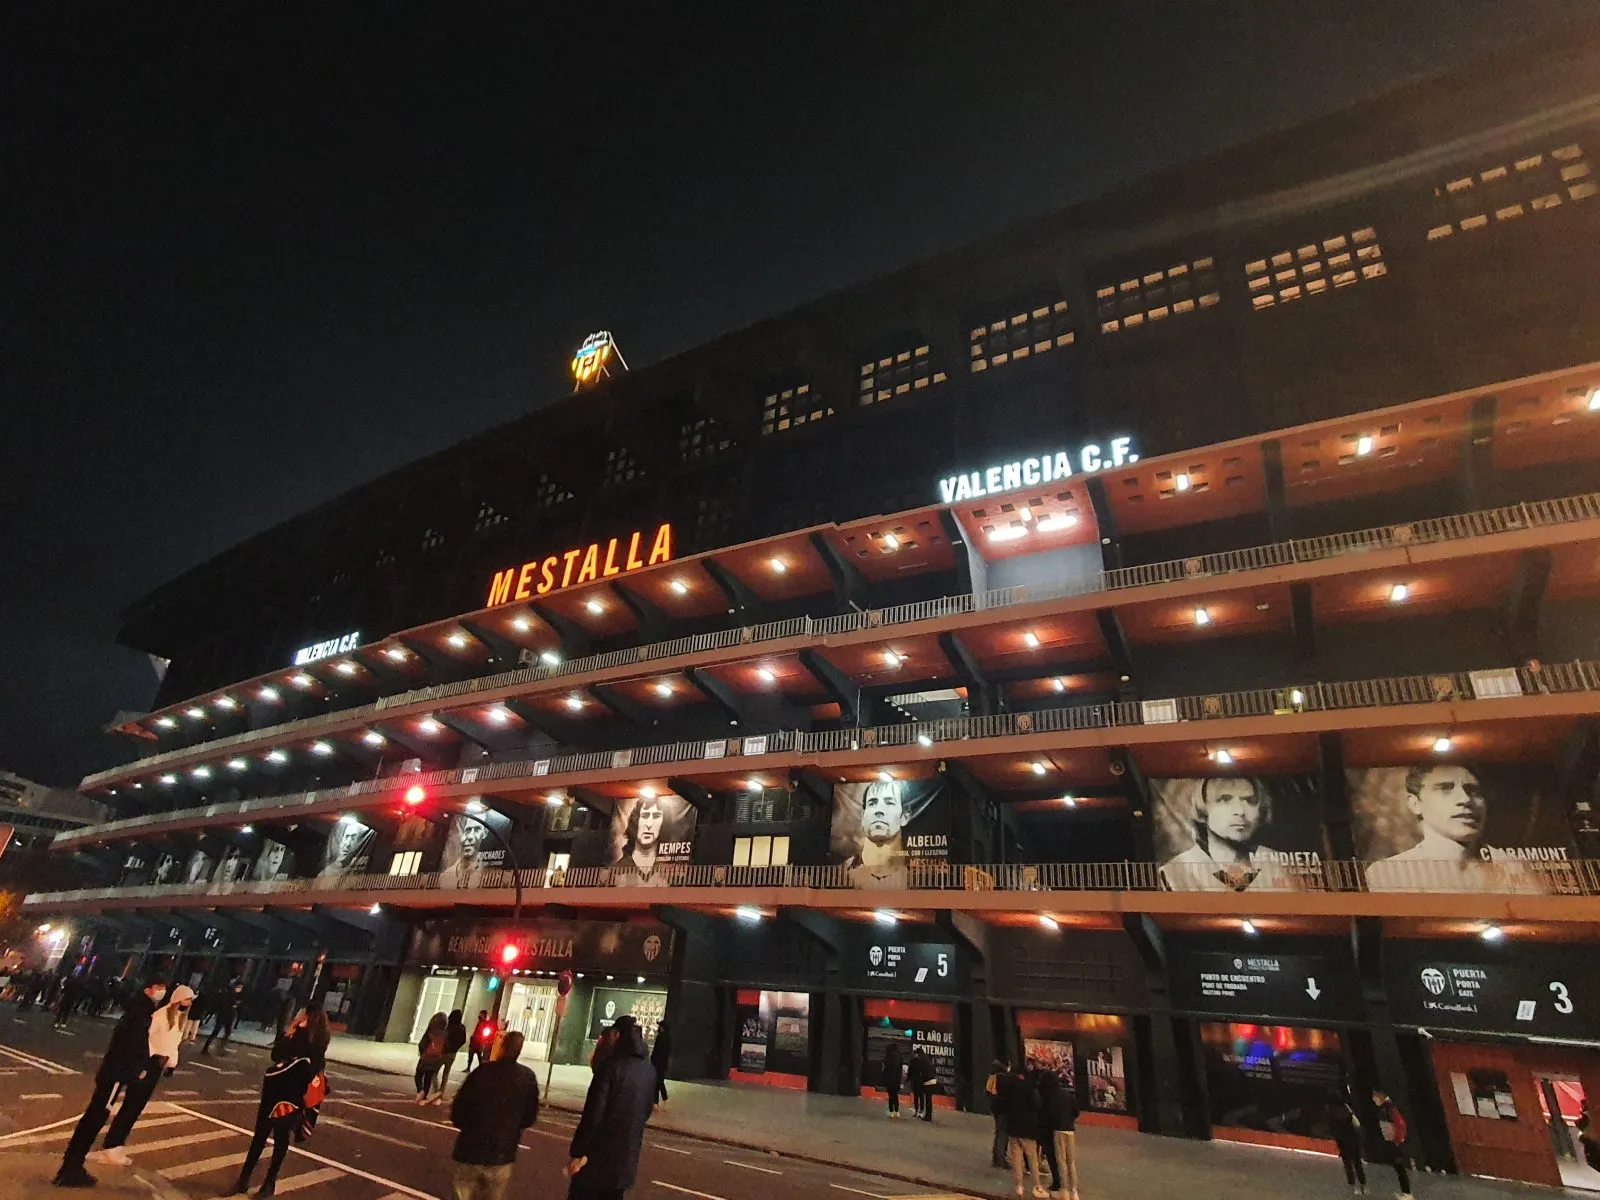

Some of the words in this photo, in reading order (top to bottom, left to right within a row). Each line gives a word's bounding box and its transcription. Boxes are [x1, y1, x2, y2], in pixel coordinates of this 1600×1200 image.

[939, 450, 1073, 503] VALENCIA
[1080, 436, 1140, 473] C.F.
[486, 523, 671, 608] MESTALLA
[658, 841, 692, 855] KEMPES
[906, 834, 948, 848] ALBELDA
[1479, 846, 1568, 861] CARAMUNT
[937, 953, 948, 977] 5
[1247, 958, 1280, 967] MESTALLA
[1453, 969, 1487, 979] PUERTA
[1456, 980, 1481, 989] PORTA
[1549, 981, 1574, 1014] 3
[916, 1030, 926, 1041] EL
[926, 1030, 941, 1043] AÑO
